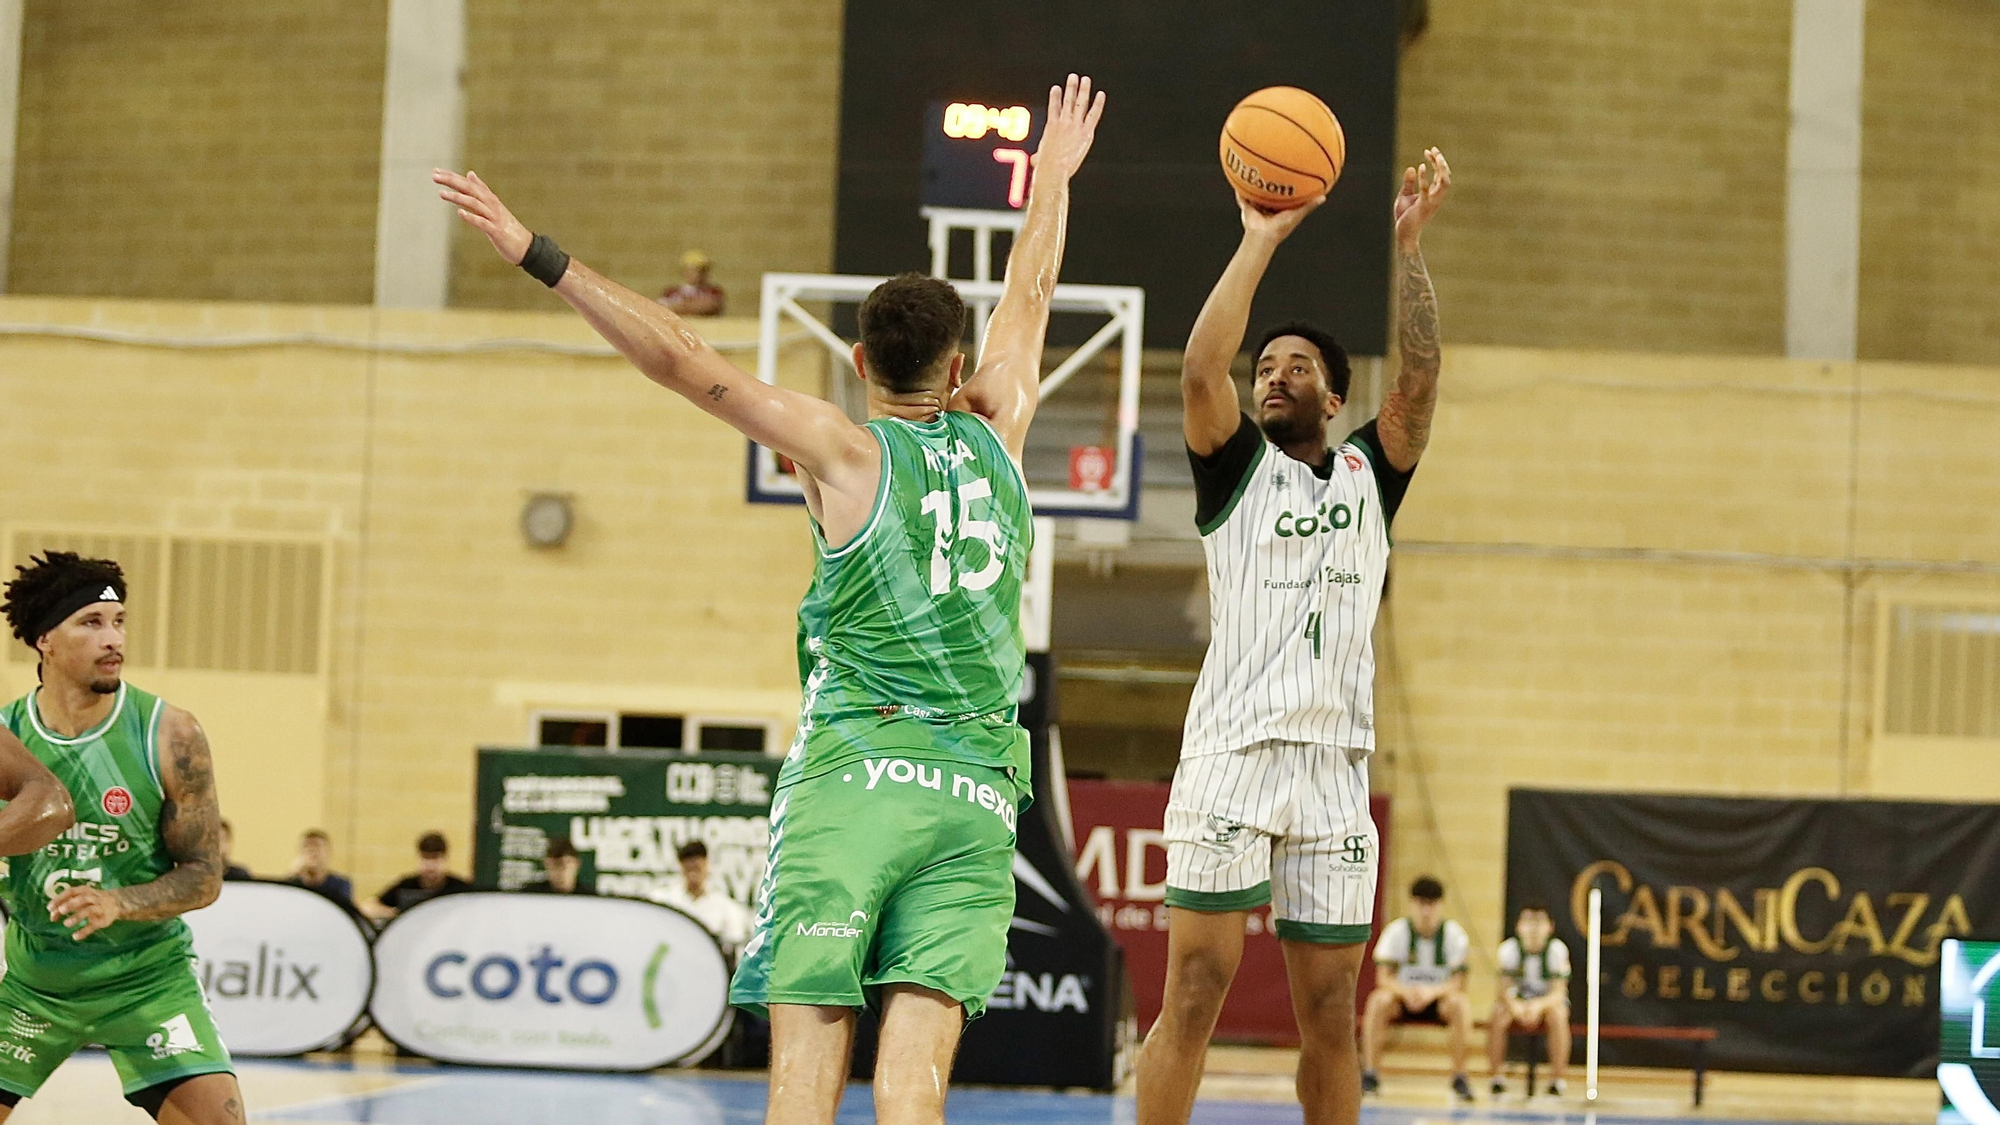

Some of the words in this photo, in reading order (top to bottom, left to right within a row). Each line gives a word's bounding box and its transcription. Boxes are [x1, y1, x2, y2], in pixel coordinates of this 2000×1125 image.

[1225, 147, 1296, 197] Wilson
[920, 477, 1007, 597] 15
[1304, 611, 1321, 660] 4
[862, 758, 941, 790] you
[796, 921, 863, 939] Monder
[424, 944, 619, 1005] coto
